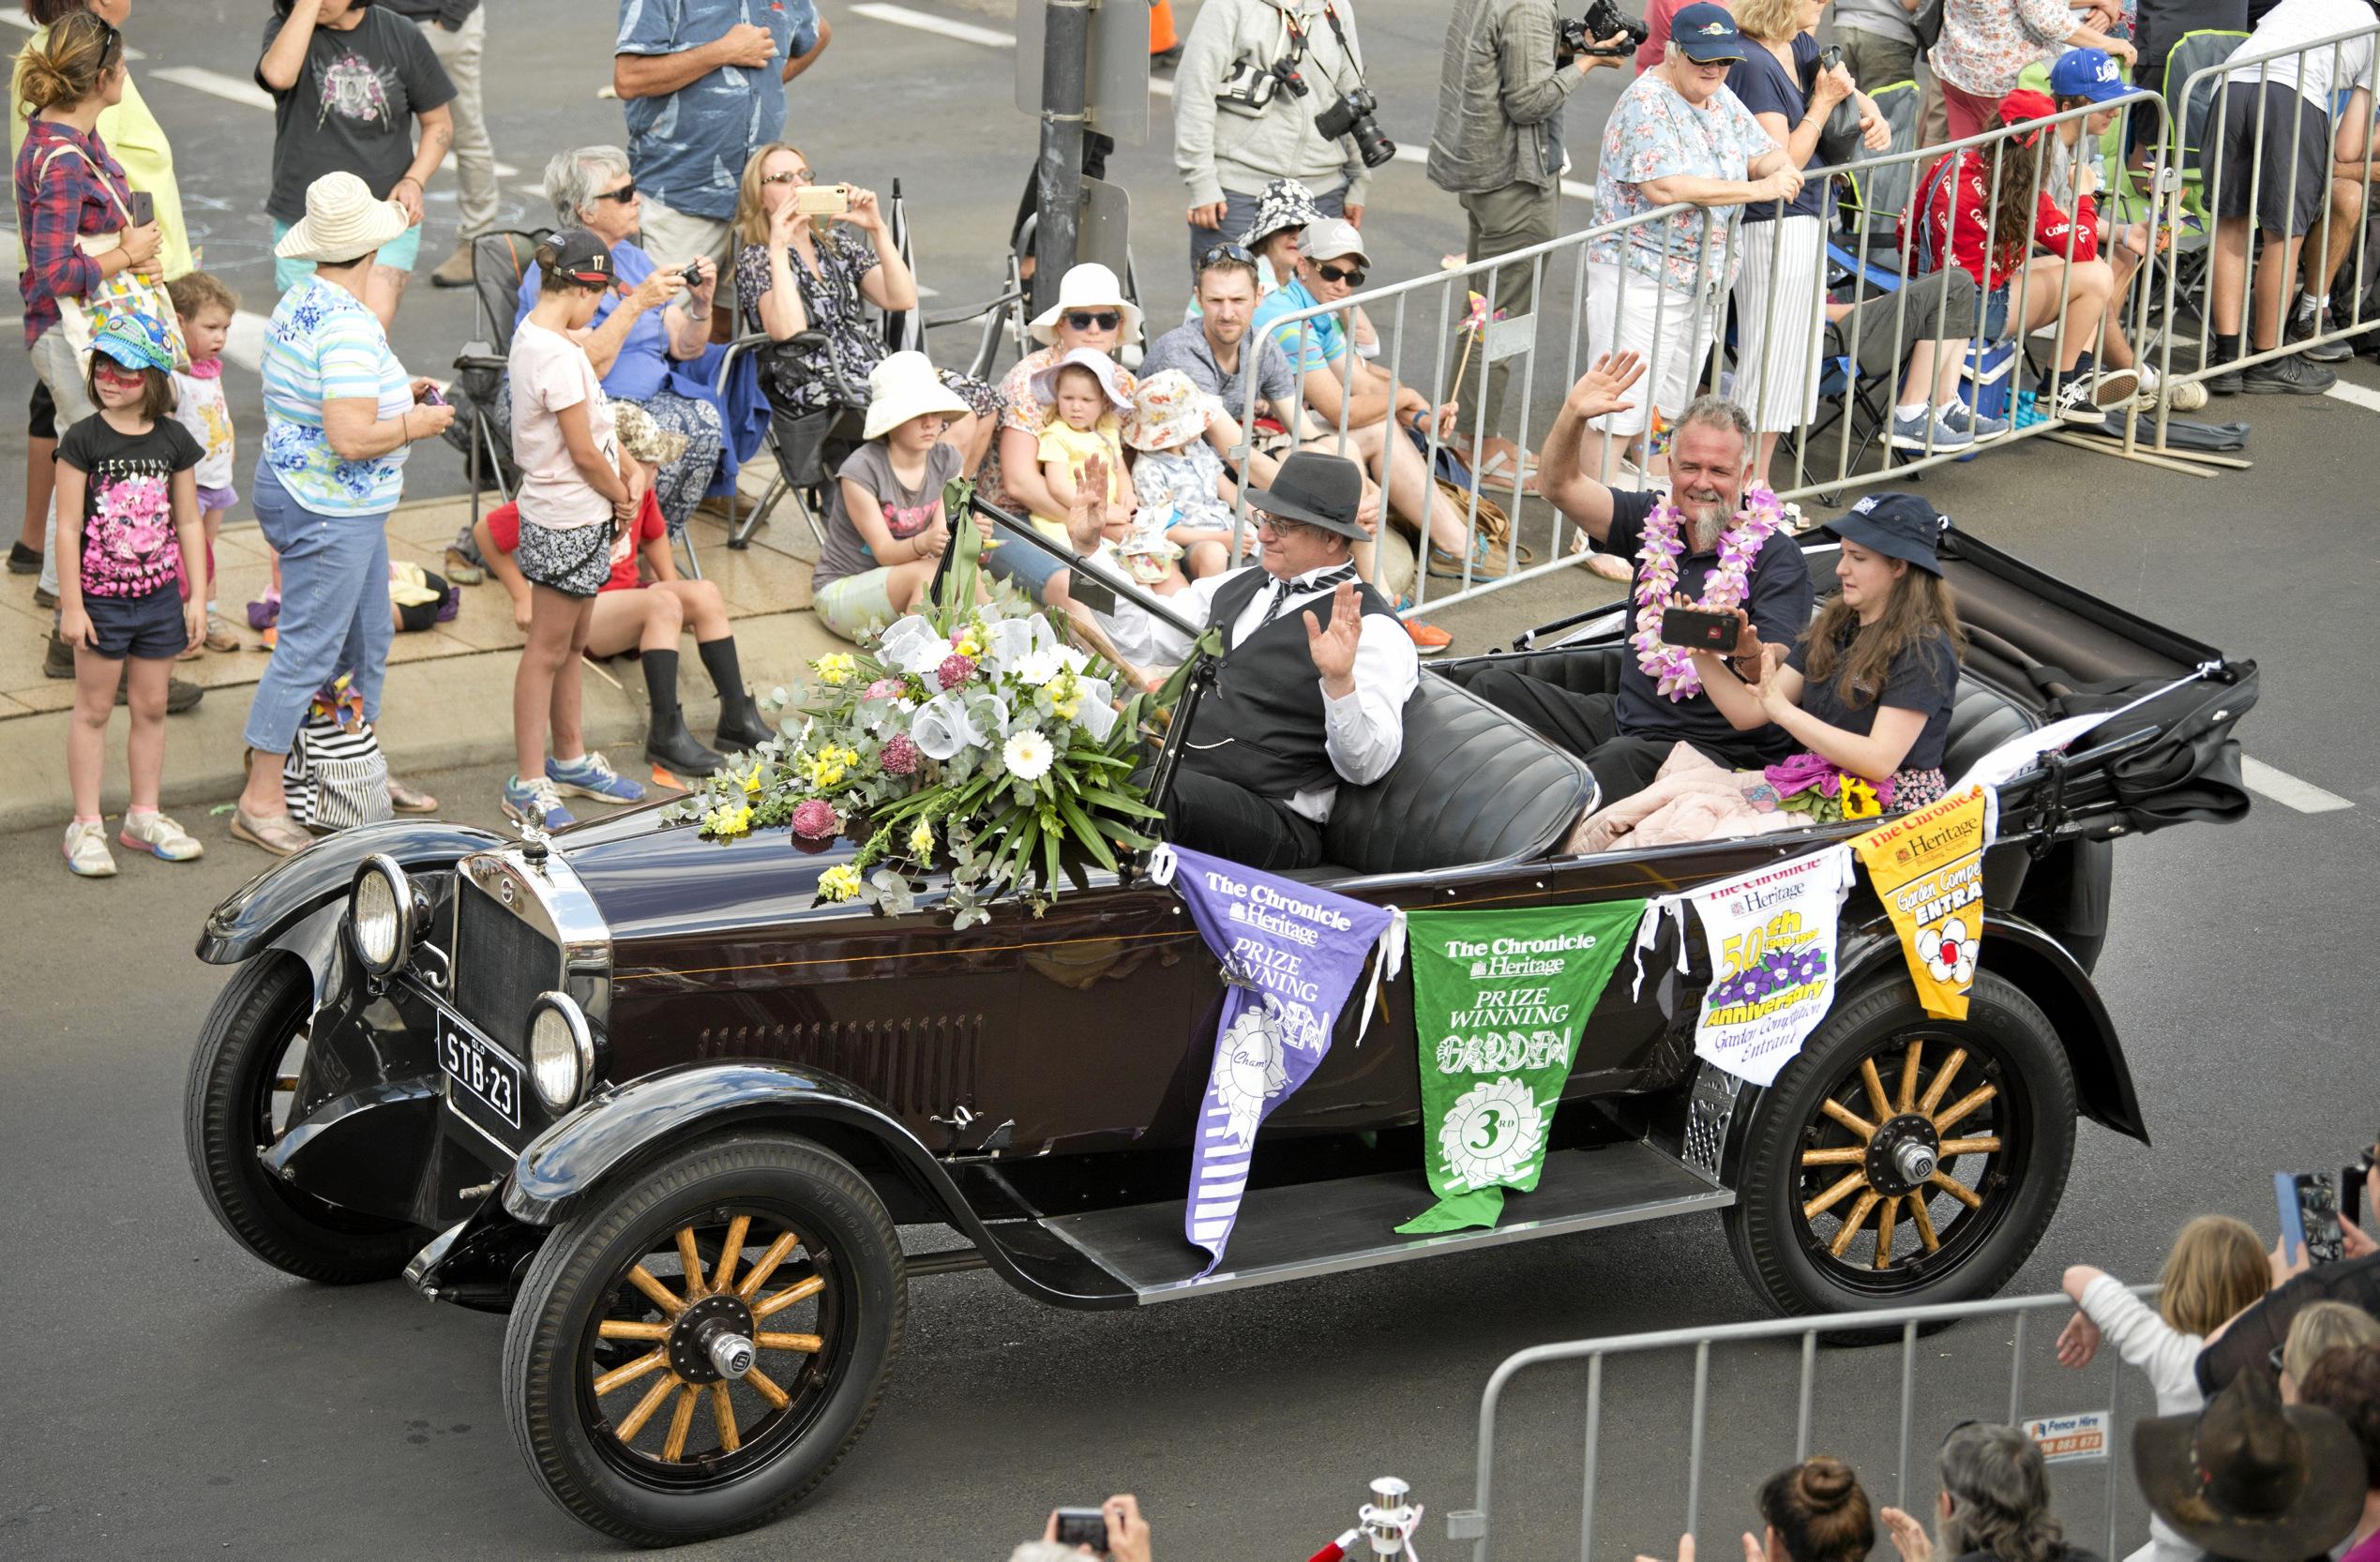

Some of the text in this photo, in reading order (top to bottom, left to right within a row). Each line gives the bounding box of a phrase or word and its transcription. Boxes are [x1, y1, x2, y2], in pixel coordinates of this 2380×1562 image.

[593, 255, 604, 270] 17
[1907, 818, 1980, 857] Heritage
[1205, 872, 1351, 931] The Chronicle
[1744, 882, 1805, 912] Heritage
[1897, 882, 1936, 914] Garden
[1915, 880, 1982, 928] ENTRA
[1246, 902, 1318, 946] Heritage
[1231, 938, 1302, 975] PRIZE
[1445, 934, 1596, 957] The Chronicle
[1488, 955, 1565, 975] Heritage
[1474, 987, 1550, 1009] PRIZE
[1702, 979, 1828, 1029] Anniversary
[1450, 1004, 1570, 1029] WINNING
[471, 1039, 485, 1056] QLD
[1436, 1028, 1572, 1074] GARDEN
[1714, 1028, 1756, 1052] Garden
[1741, 1031, 1797, 1062] Entrant
[2048, 1419, 2076, 1432] Fence
[2079, 1416, 2099, 1427] Hire
[2079, 1434, 2101, 1449] 673
